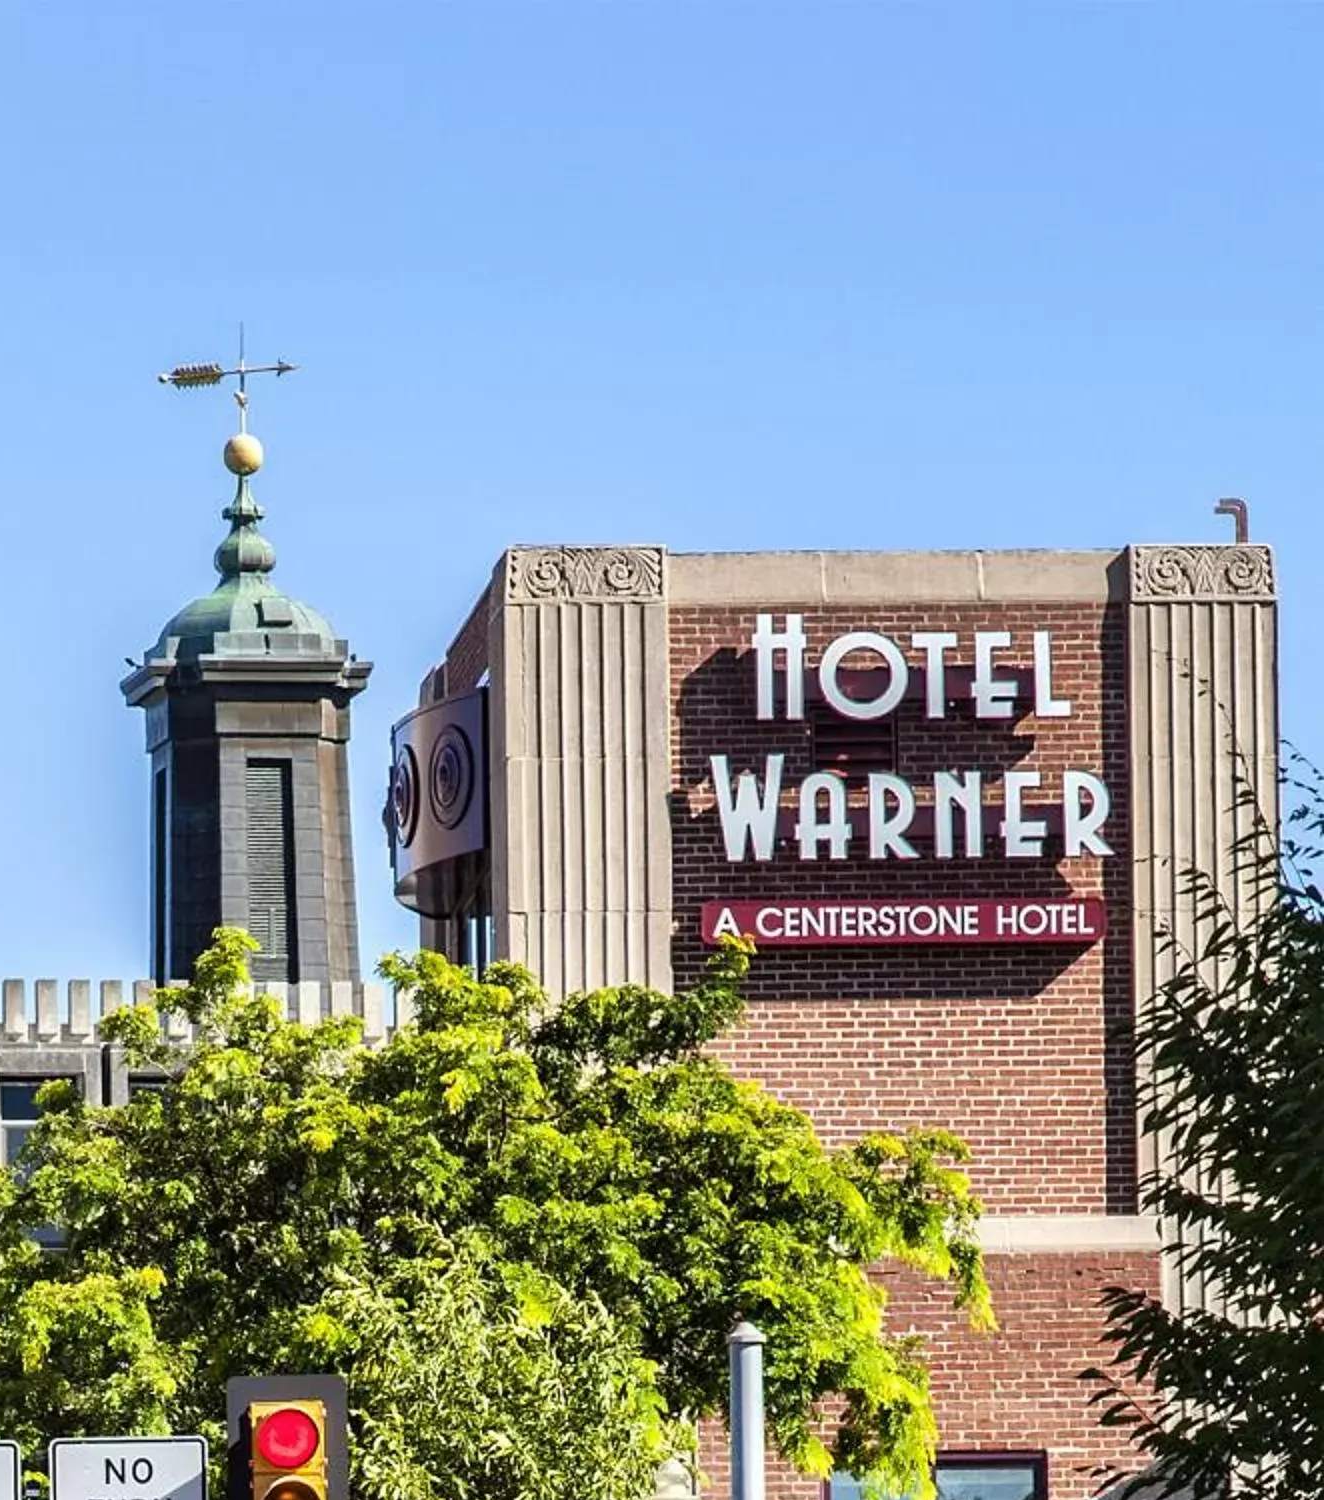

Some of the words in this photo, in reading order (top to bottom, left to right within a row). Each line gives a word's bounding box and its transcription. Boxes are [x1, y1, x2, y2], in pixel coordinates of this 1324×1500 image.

[752, 614, 1071, 720] HOTEL
[710, 753, 1116, 862] WARNER
[713, 907, 740, 937] A
[756, 906, 979, 937] CENTERSTONE
[997, 904, 1094, 936] HOTEL
[104, 1457, 153, 1485] NO
